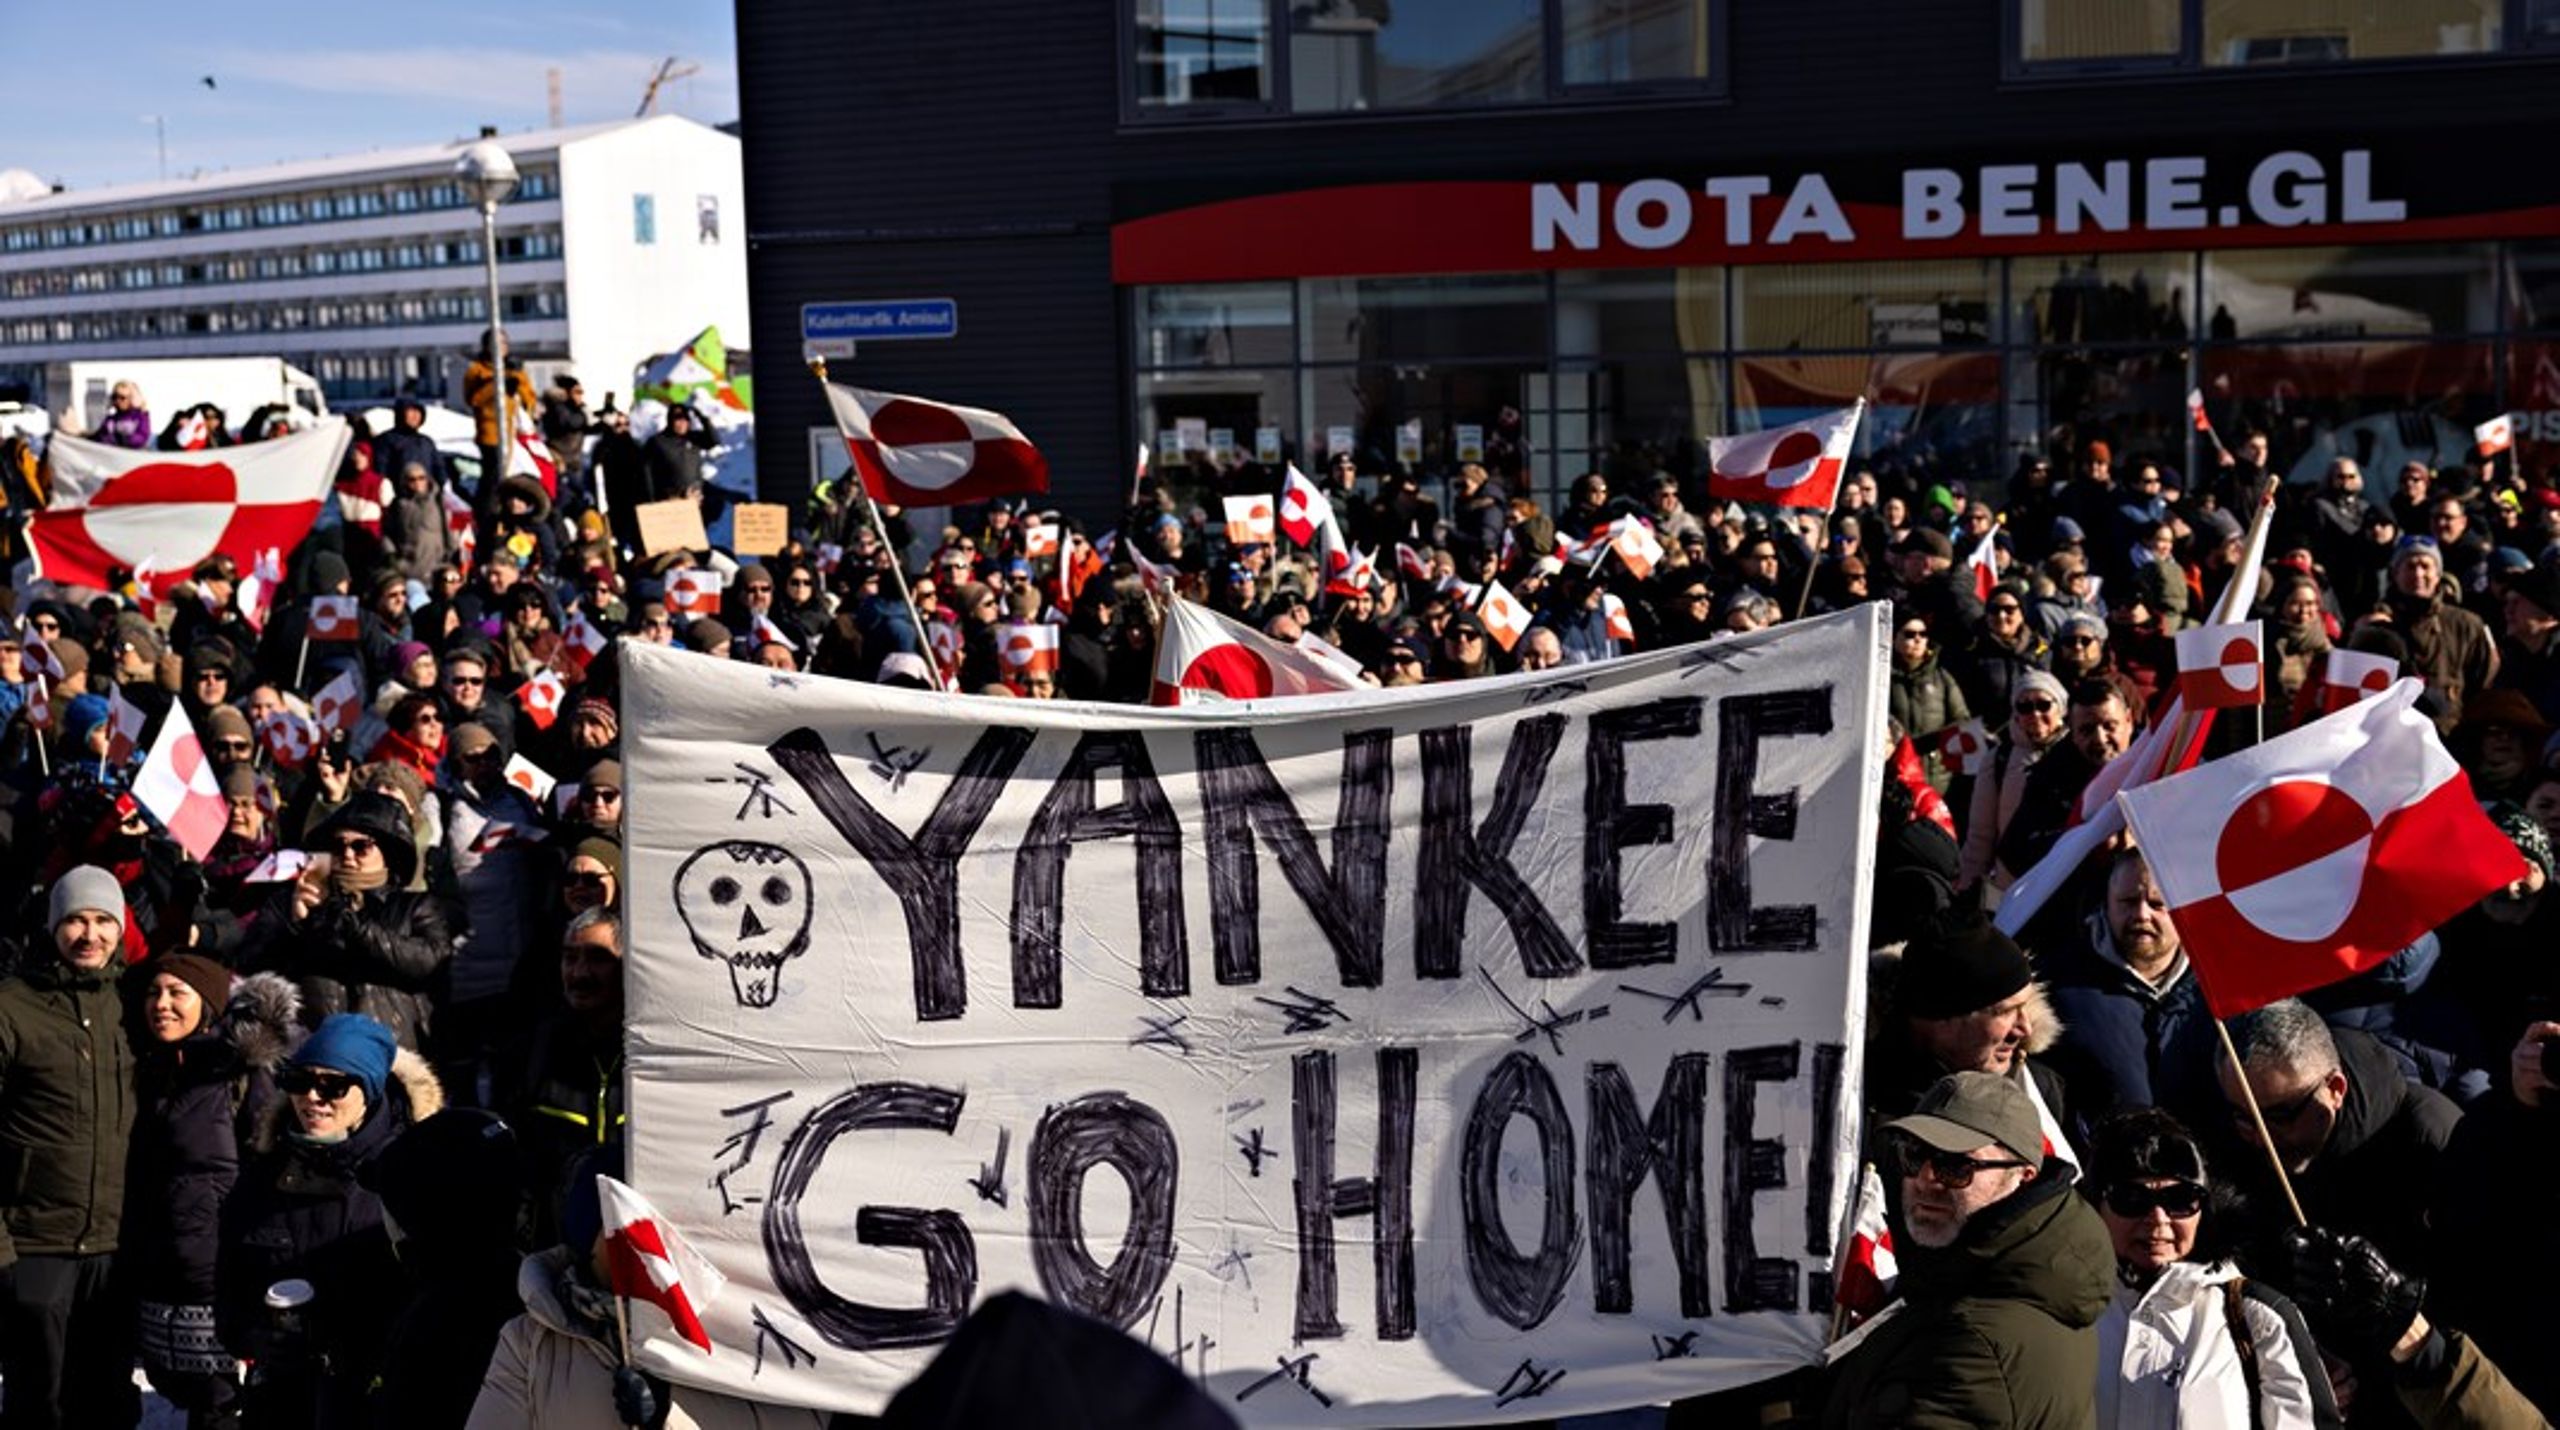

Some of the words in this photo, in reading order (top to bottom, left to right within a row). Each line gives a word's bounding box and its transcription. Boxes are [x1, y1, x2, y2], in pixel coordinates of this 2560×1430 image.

[1531, 173, 1856, 251] NOTA
[1902, 150, 2406, 240] BENE.GL
[767, 682, 1834, 1021] YANKEE
[761, 1081, 1178, 1350] GO
[1292, 1039, 1846, 1345] HOME!
